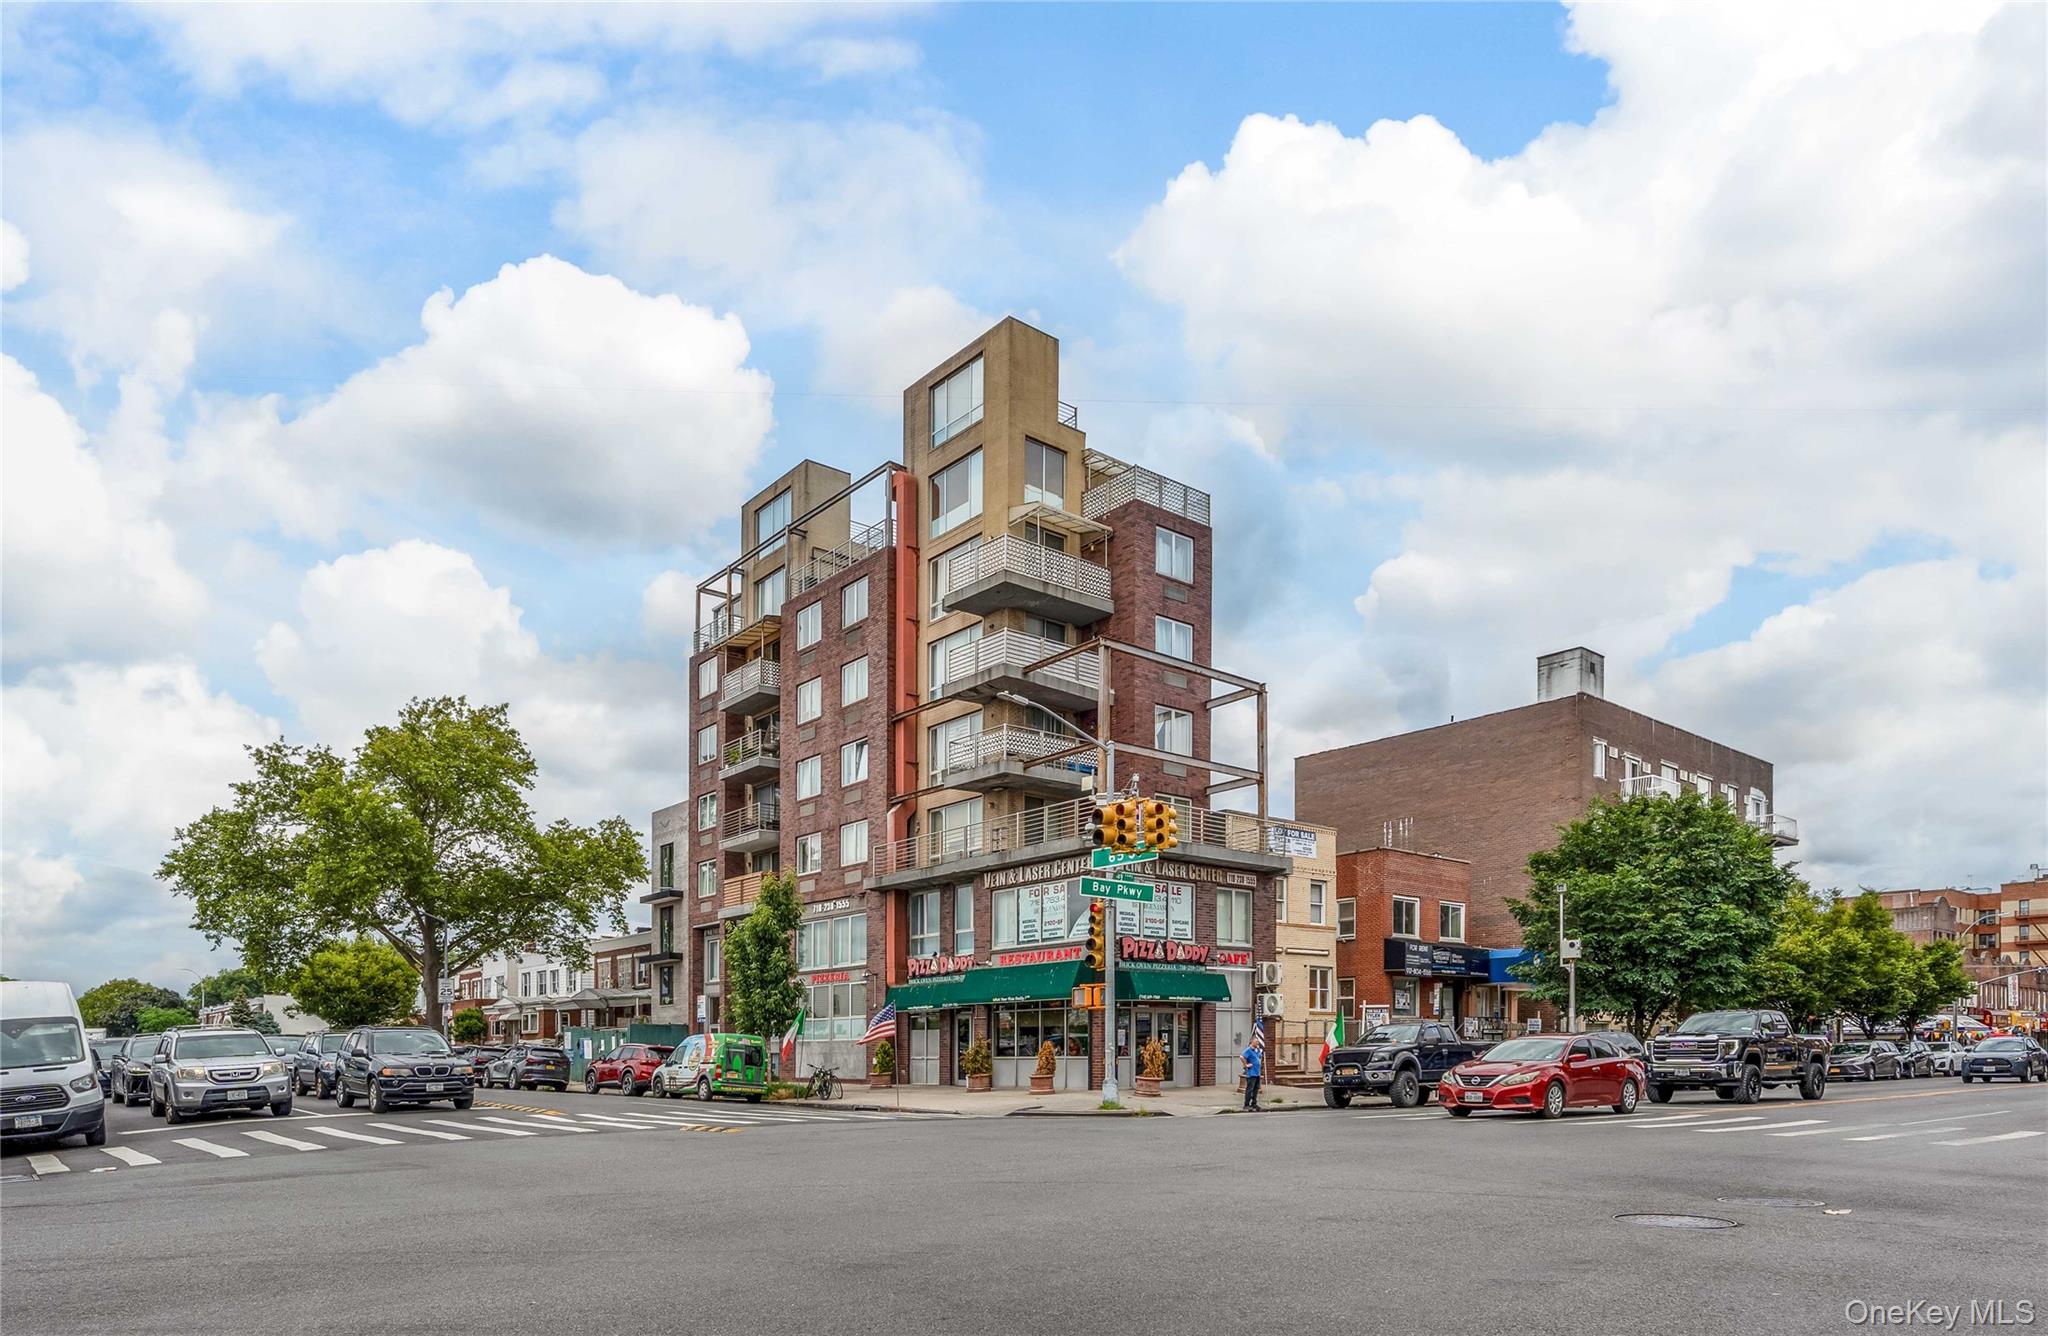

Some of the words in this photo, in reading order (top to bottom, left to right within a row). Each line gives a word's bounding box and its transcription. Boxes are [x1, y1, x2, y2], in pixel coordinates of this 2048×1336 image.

[1287, 830, 1299, 838] FOR
[1301, 831, 1315, 839] SALE
[984, 871, 1006, 889] VEIN
[1009, 868, 1017, 884] &
[1020, 864, 1051, 882] LASER
[1144, 861, 1153, 875] &
[1156, 861, 1186, 878] LASER
[1189, 864, 1223, 883] CENTER
[1092, 881, 1111, 896] Bay
[1116, 884, 1142, 898] Pkwy
[998, 947, 1082, 966] RESTAURANT
[1121, 937, 1165, 960] PIZZA
[1166, 940, 1210, 963] DADDY
[907, 957, 938, 976] PIZZA
[810, 971, 850, 984] PIZZERIA
[440, 988, 453, 996] 25
